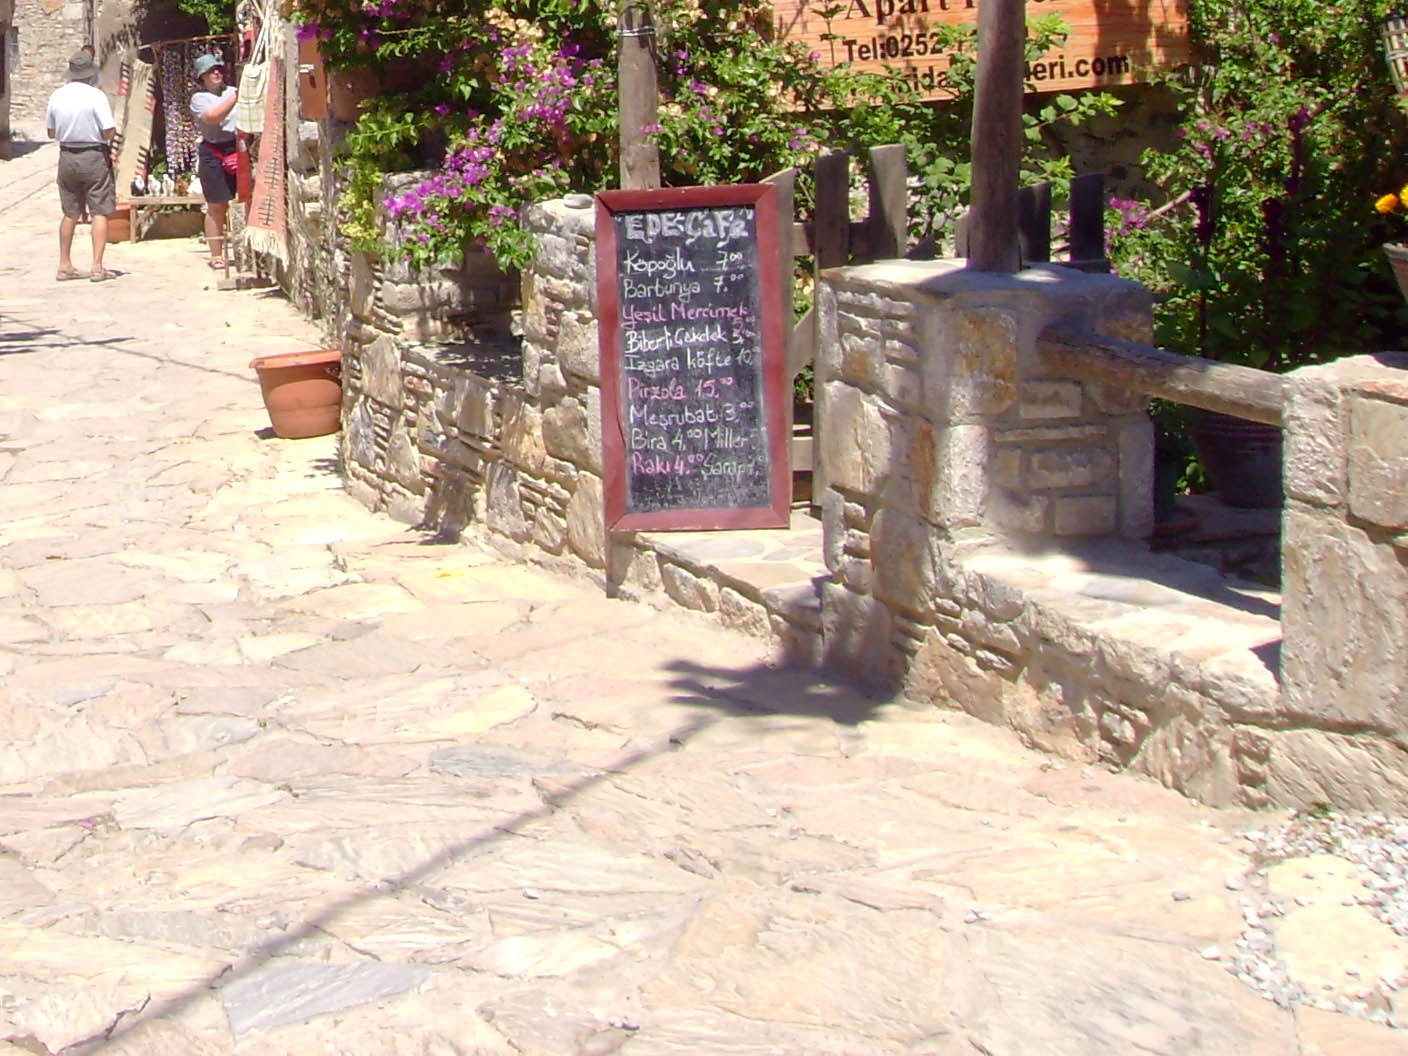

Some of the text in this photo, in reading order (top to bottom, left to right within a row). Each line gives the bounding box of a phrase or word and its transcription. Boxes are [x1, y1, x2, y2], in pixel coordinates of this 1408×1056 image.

[621, 303, 749, 329] Yeşil Mercimek
[687, 347, 732, 374] köfte
[628, 376, 687, 400] Pirzola
[629, 404, 717, 430] Meşrubat
[631, 427, 666, 450] Bira
[704, 426, 749, 450] Miller
